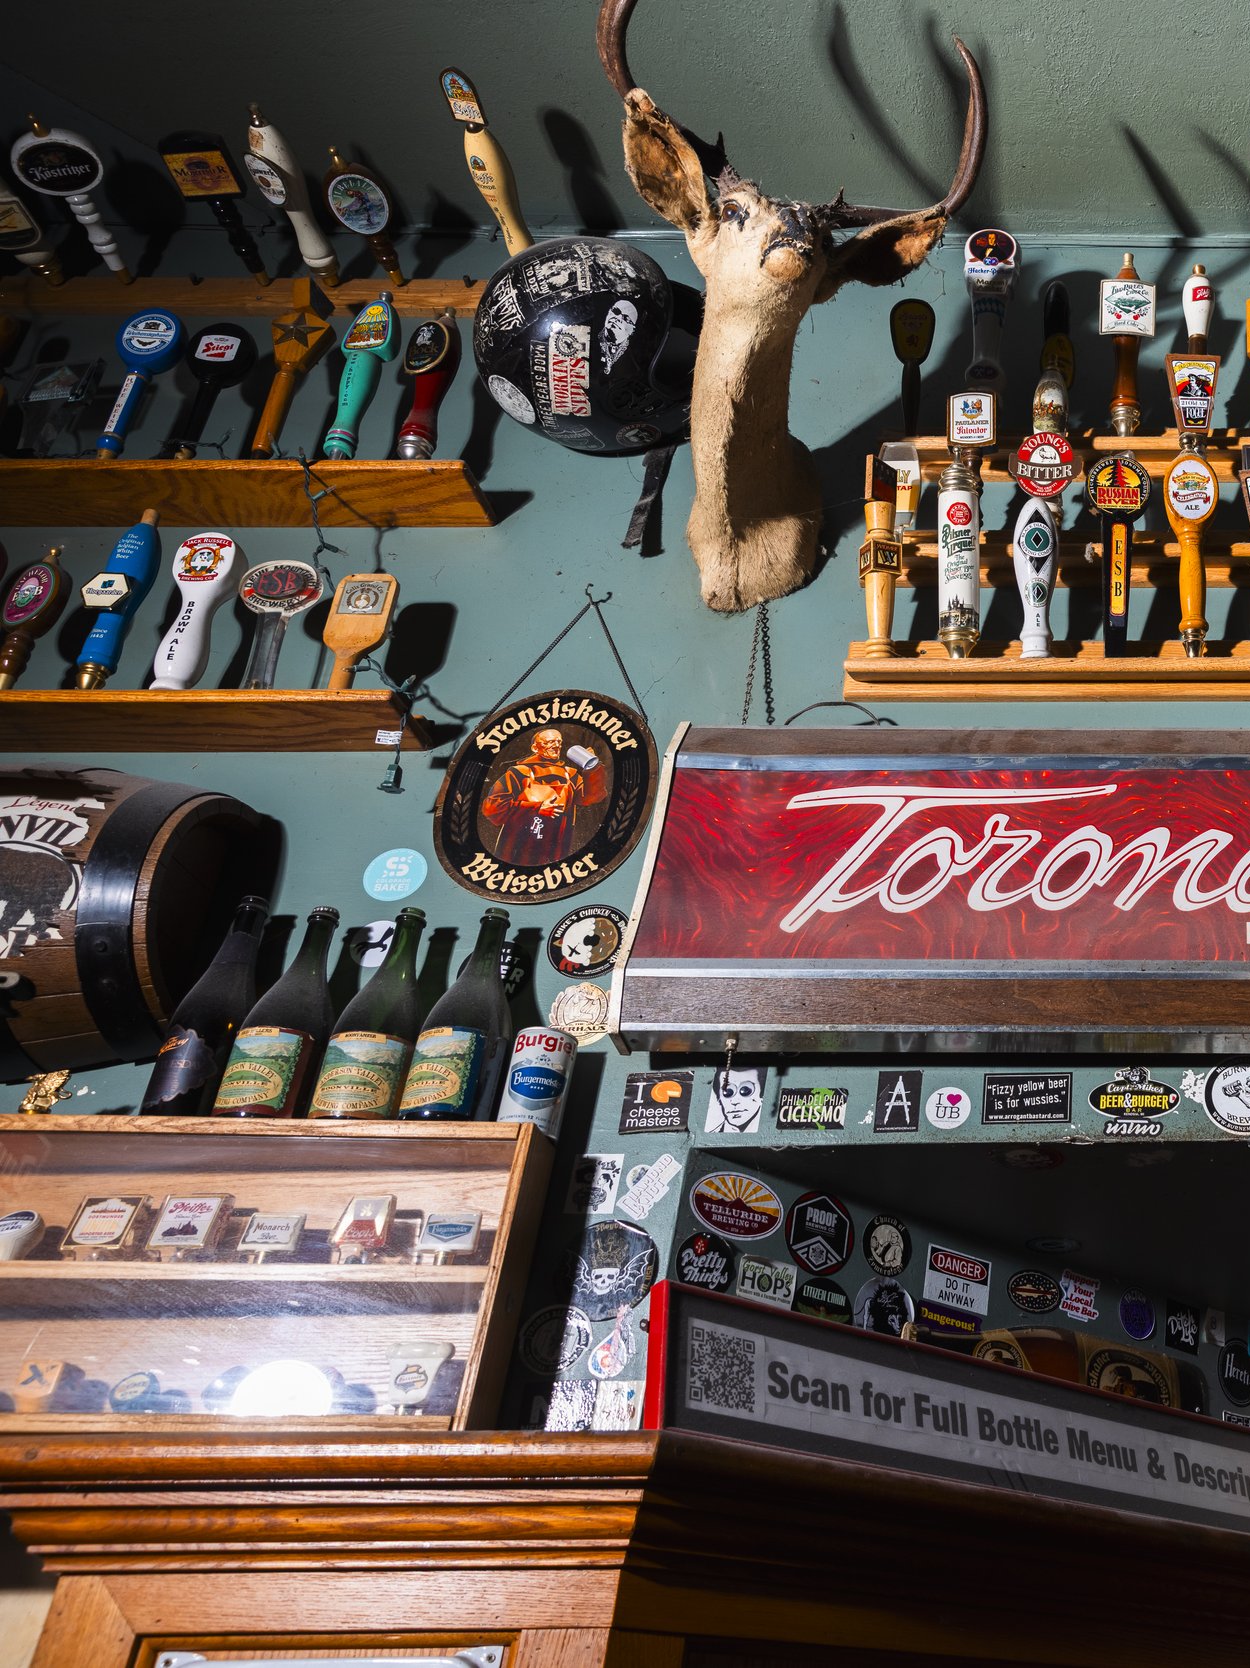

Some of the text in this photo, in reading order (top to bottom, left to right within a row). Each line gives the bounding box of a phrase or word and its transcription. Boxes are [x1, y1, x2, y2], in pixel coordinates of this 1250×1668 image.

[202, 342, 234, 354] Stiegl
[552, 354, 569, 415] WORKIN'
[956, 425, 988, 434] Salvator
[1021, 433, 1069, 454] YOUNG'S
[1017, 462, 1072, 479] BITTER
[1098, 489, 1139, 499] RUSSIAN
[186, 537, 230, 547] JACK RUSSELL
[167, 600, 196, 661] BROWN ALE
[475, 697, 638, 755] Franziskaner
[462, 852, 599, 894] Weissbier
[555, 907, 611, 938] MIKE'S CHICKEN
[633, 1082, 644, 1103] I
[1017, 1081, 1046, 1095] yellow
[1049, 1078, 1068, 1090] beer
[232, 1090, 269, 1105] COMPANY
[342, 1098, 378, 1108] COMPANY
[781, 1094, 845, 1107] PHILADELPHIA
[935, 1094, 943, 1105] I
[994, 1099, 1002, 1110] is
[1004, 1097, 1021, 1109] for
[625, 1115, 682, 1127] masters
[629, 1107, 680, 1119] cheese
[779, 1105, 842, 1124] CICLISMO
[988, 1113, 1064, 1121] www.arrogantbastard.com
[168, 1200, 214, 1215] Pfeiffer
[703, 1202, 768, 1224] TELLURIDE
[712, 1214, 750, 1228] BREWING
[806, 1206, 838, 1227] PROOF
[252, 1222, 291, 1235] Monarch
[681, 1248, 726, 1272] Pretty
[937, 1253, 982, 1280] DANGER
[683, 1266, 728, 1290] Things
[742, 1260, 794, 1282] Gorst Valley
[1063, 1270, 1100, 1289] Support
[741, 1271, 792, 1298] HOPS
[945, 1278, 970, 1292] DO IT
[1073, 1285, 1095, 1297] Your
[938, 1290, 974, 1308] ANYWAY
[1068, 1293, 1093, 1307] Local
[1060, 1300, 1098, 1319] Dive Bar
[920, 1307, 975, 1332] Dangerous!
[767, 1361, 852, 1411] Scan
[860, 1381, 907, 1424] for
[913, 1394, 969, 1436] Full
[977, 1409, 1060, 1456] Bottle
[1068, 1428, 1138, 1474] Menu
[1146, 1447, 1167, 1480] &
